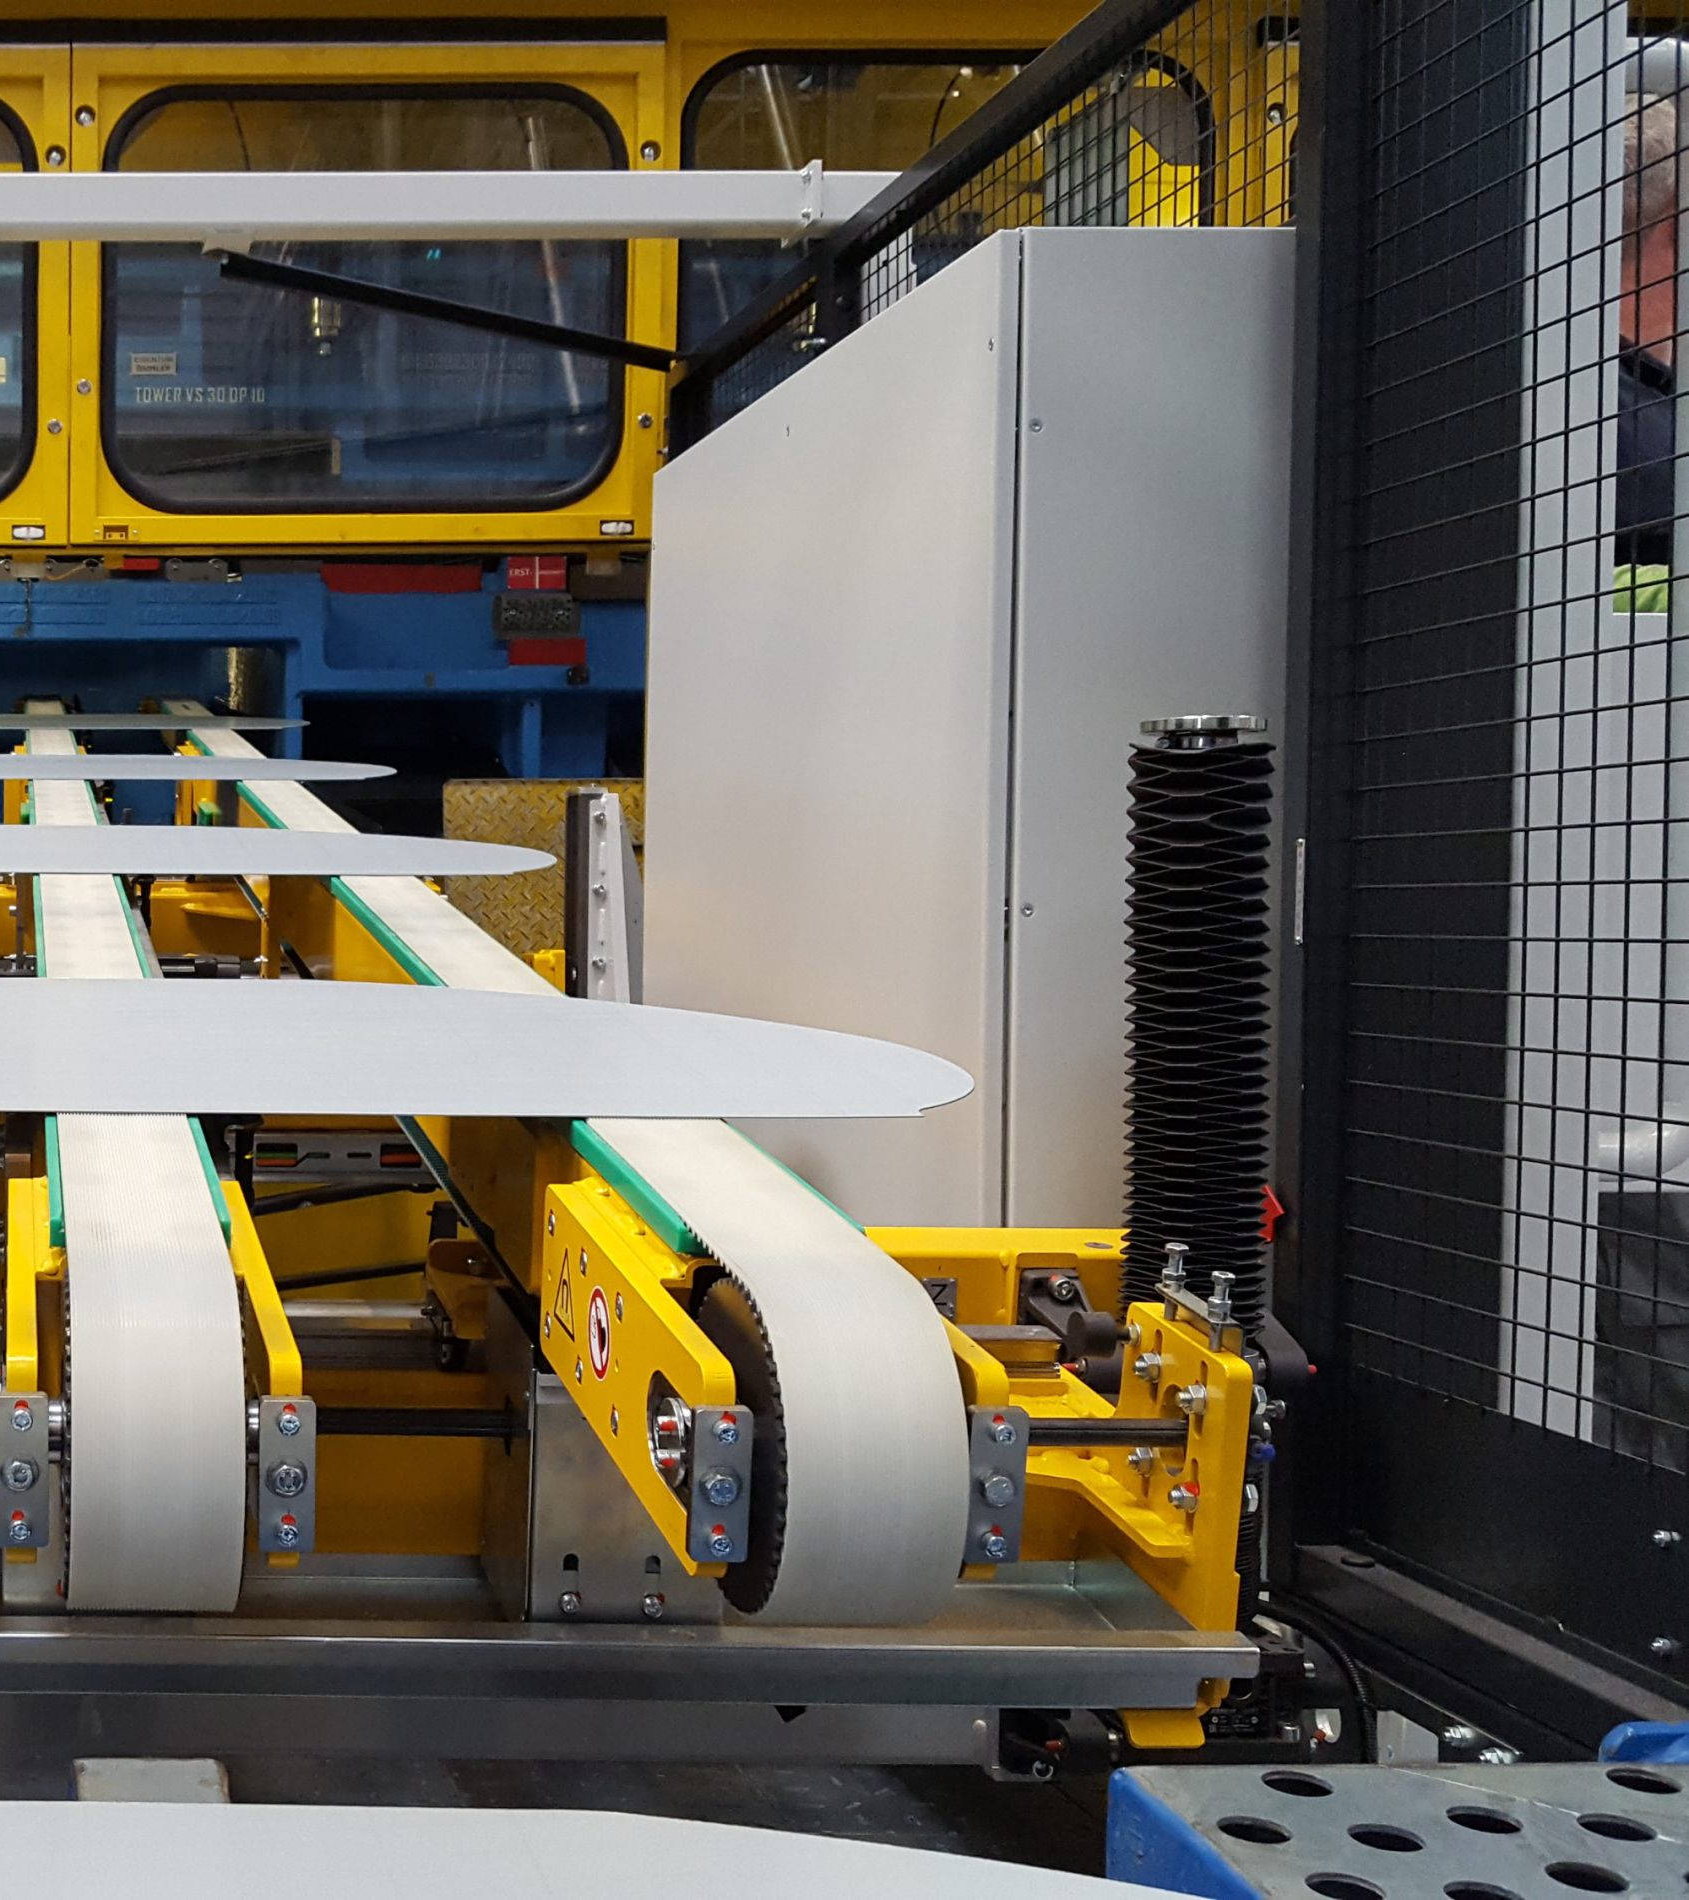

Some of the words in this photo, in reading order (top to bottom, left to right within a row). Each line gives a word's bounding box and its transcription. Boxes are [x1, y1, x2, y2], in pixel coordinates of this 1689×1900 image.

[135, 386, 182, 404] TOWER
[186, 386, 203, 403] VS
[931, 1284, 948, 1305] Z
